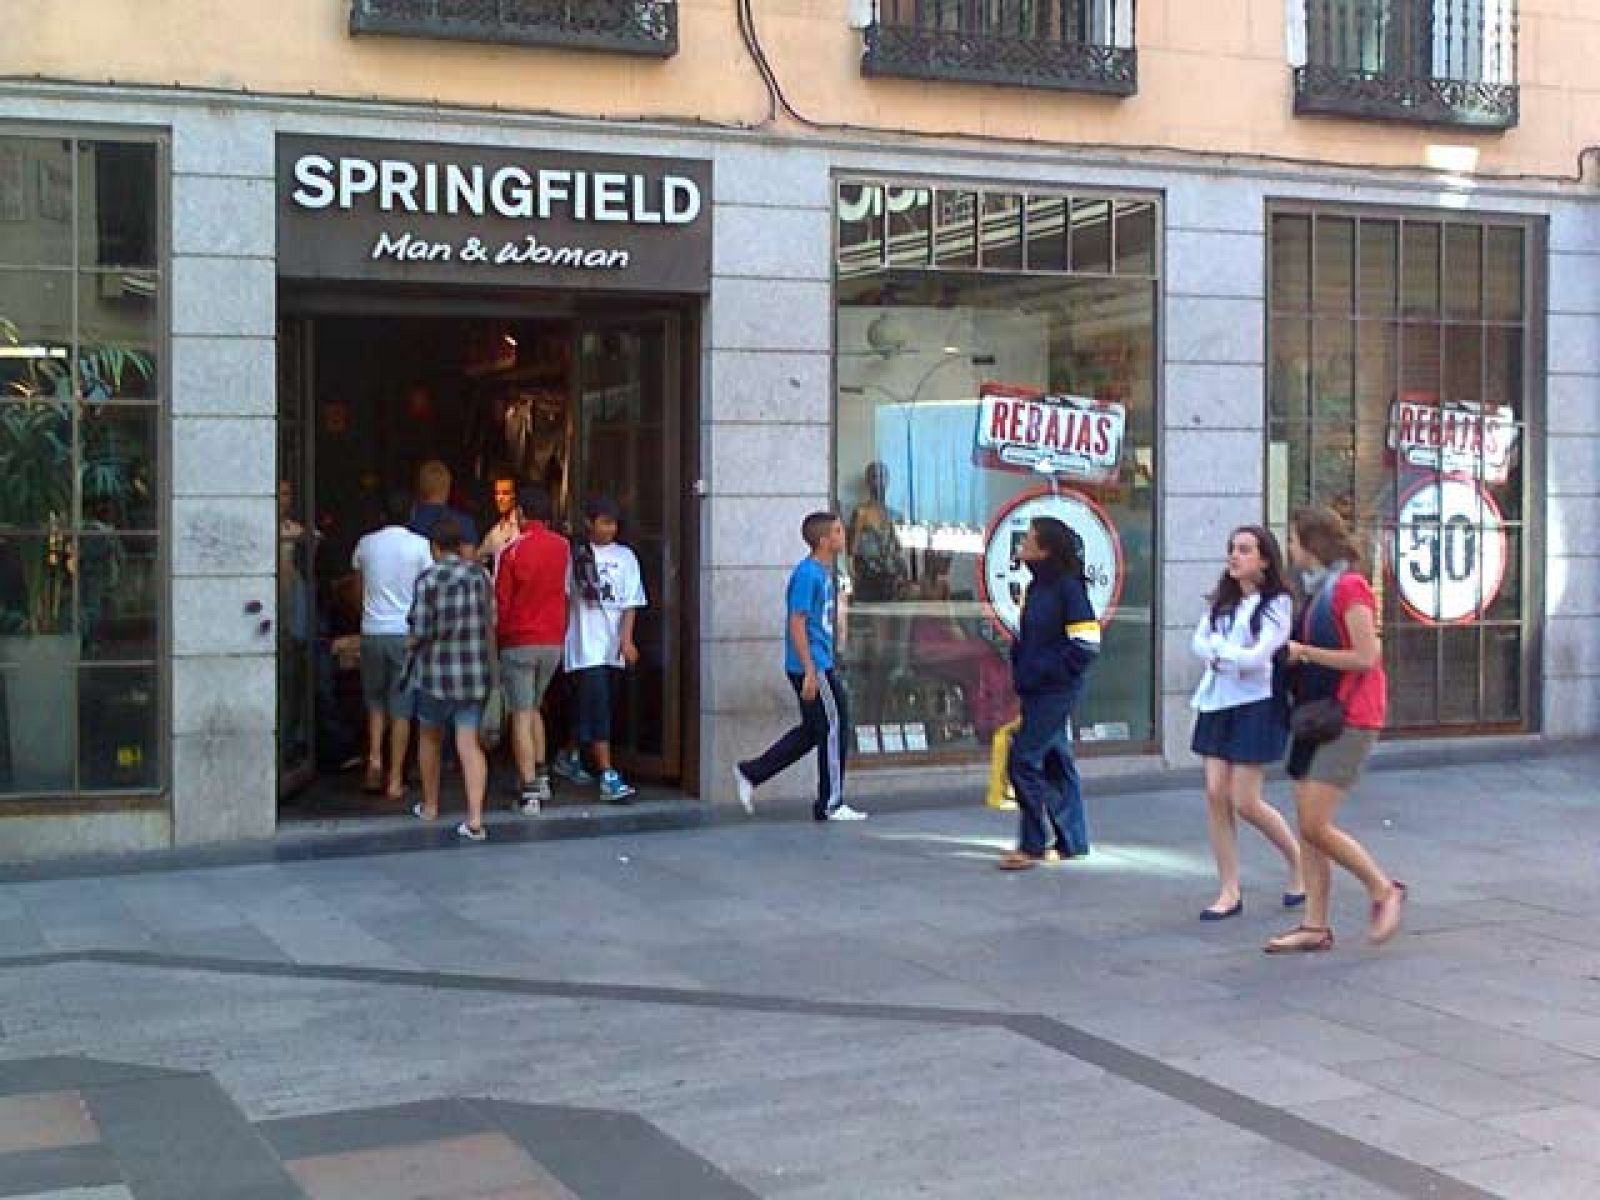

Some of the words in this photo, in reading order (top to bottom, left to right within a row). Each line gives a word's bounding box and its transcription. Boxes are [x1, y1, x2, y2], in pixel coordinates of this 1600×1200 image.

[292, 154, 700, 225] SPRINGFIELD
[372, 232, 452, 262] Man
[459, 237, 488, 262] &
[990, 401, 1111, 456] REBAJAS
[1401, 406, 1501, 454] REBAJAS
